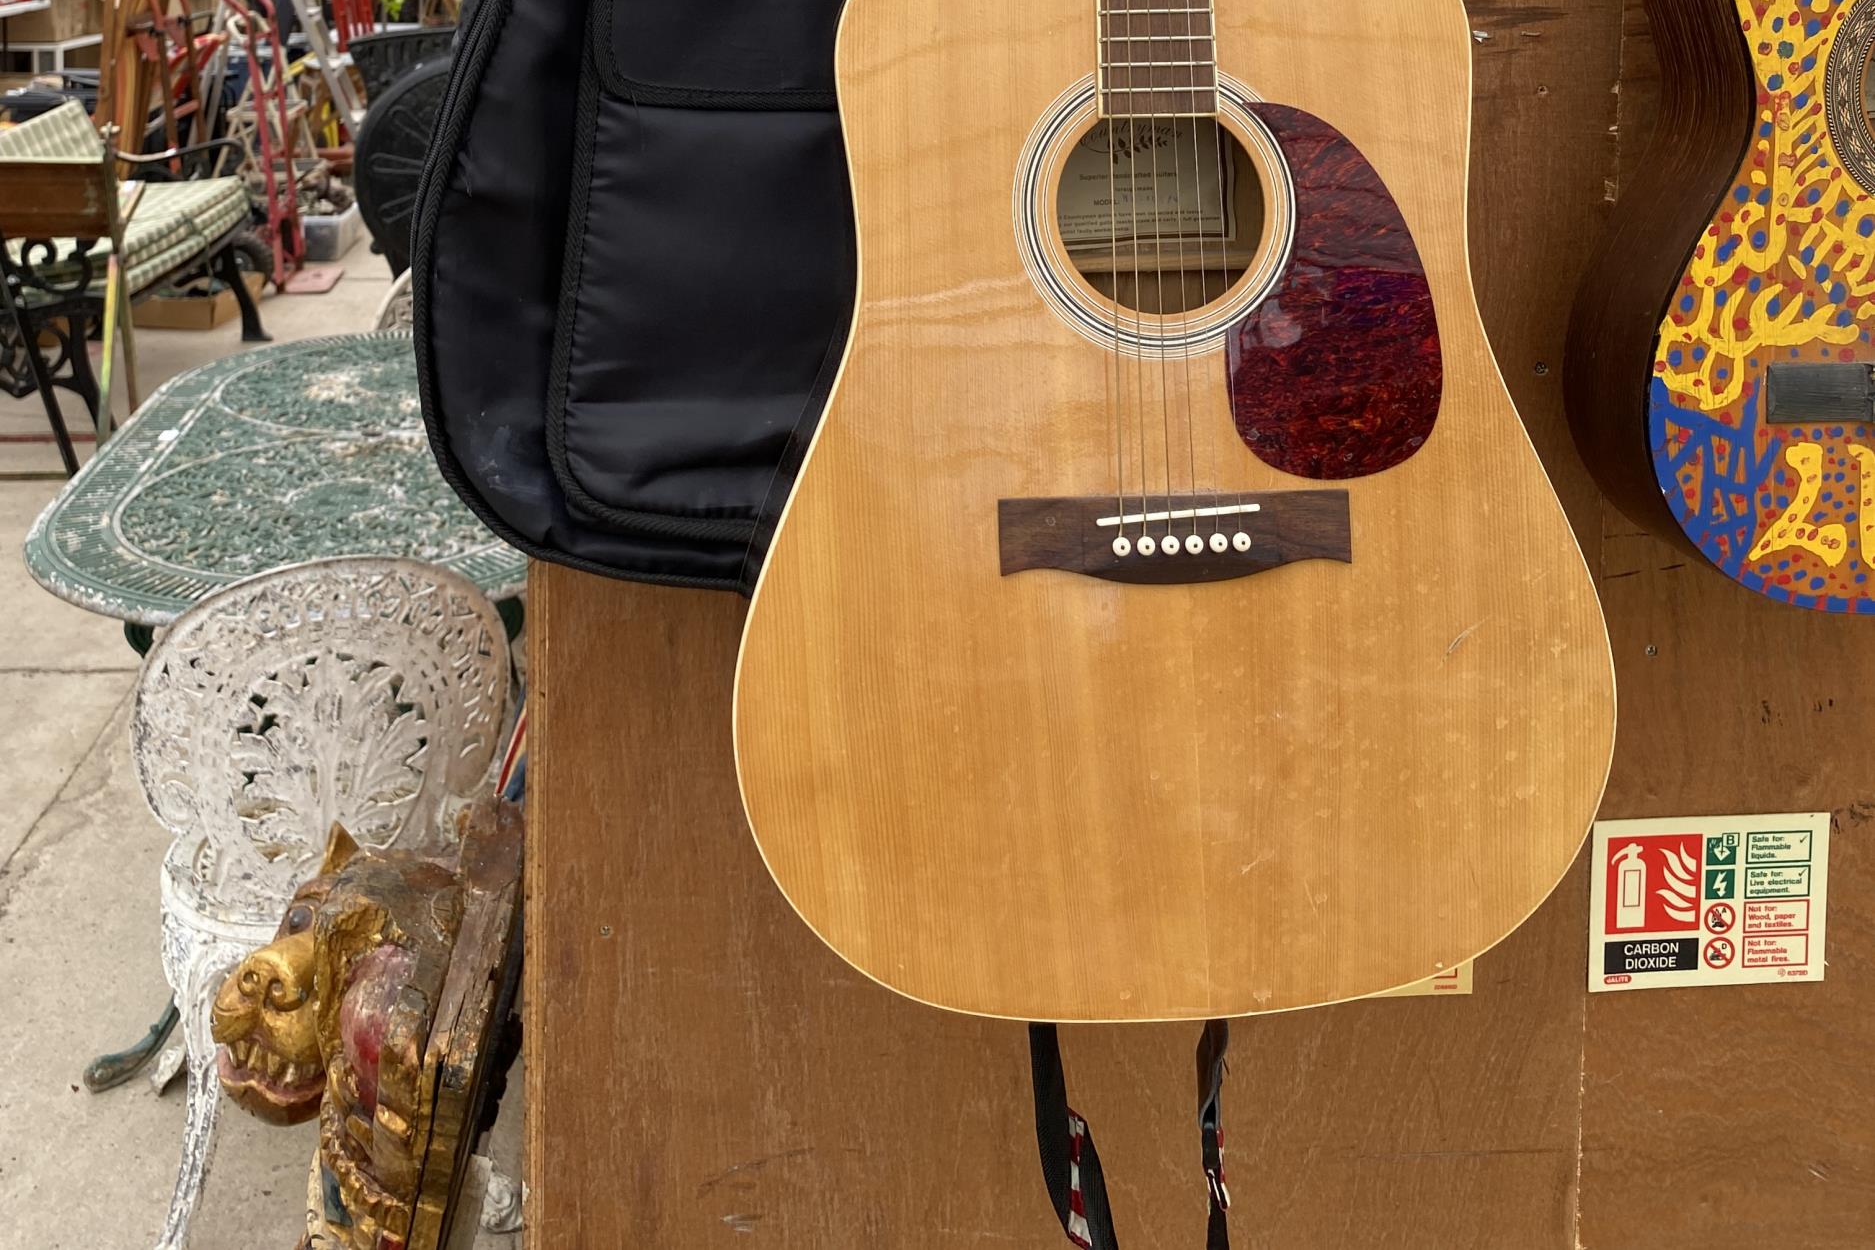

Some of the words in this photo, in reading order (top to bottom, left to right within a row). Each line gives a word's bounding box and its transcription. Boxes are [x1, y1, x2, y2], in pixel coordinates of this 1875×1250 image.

[1726, 835, 1735, 846] B
[1752, 835, 1769, 843] Safe
[1768, 878, 1802, 886] electrical
[1749, 887, 1790, 895] equipment.
[1624, 942, 1679, 956] CARBON
[1625, 956, 1677, 970] DIOXIDE
